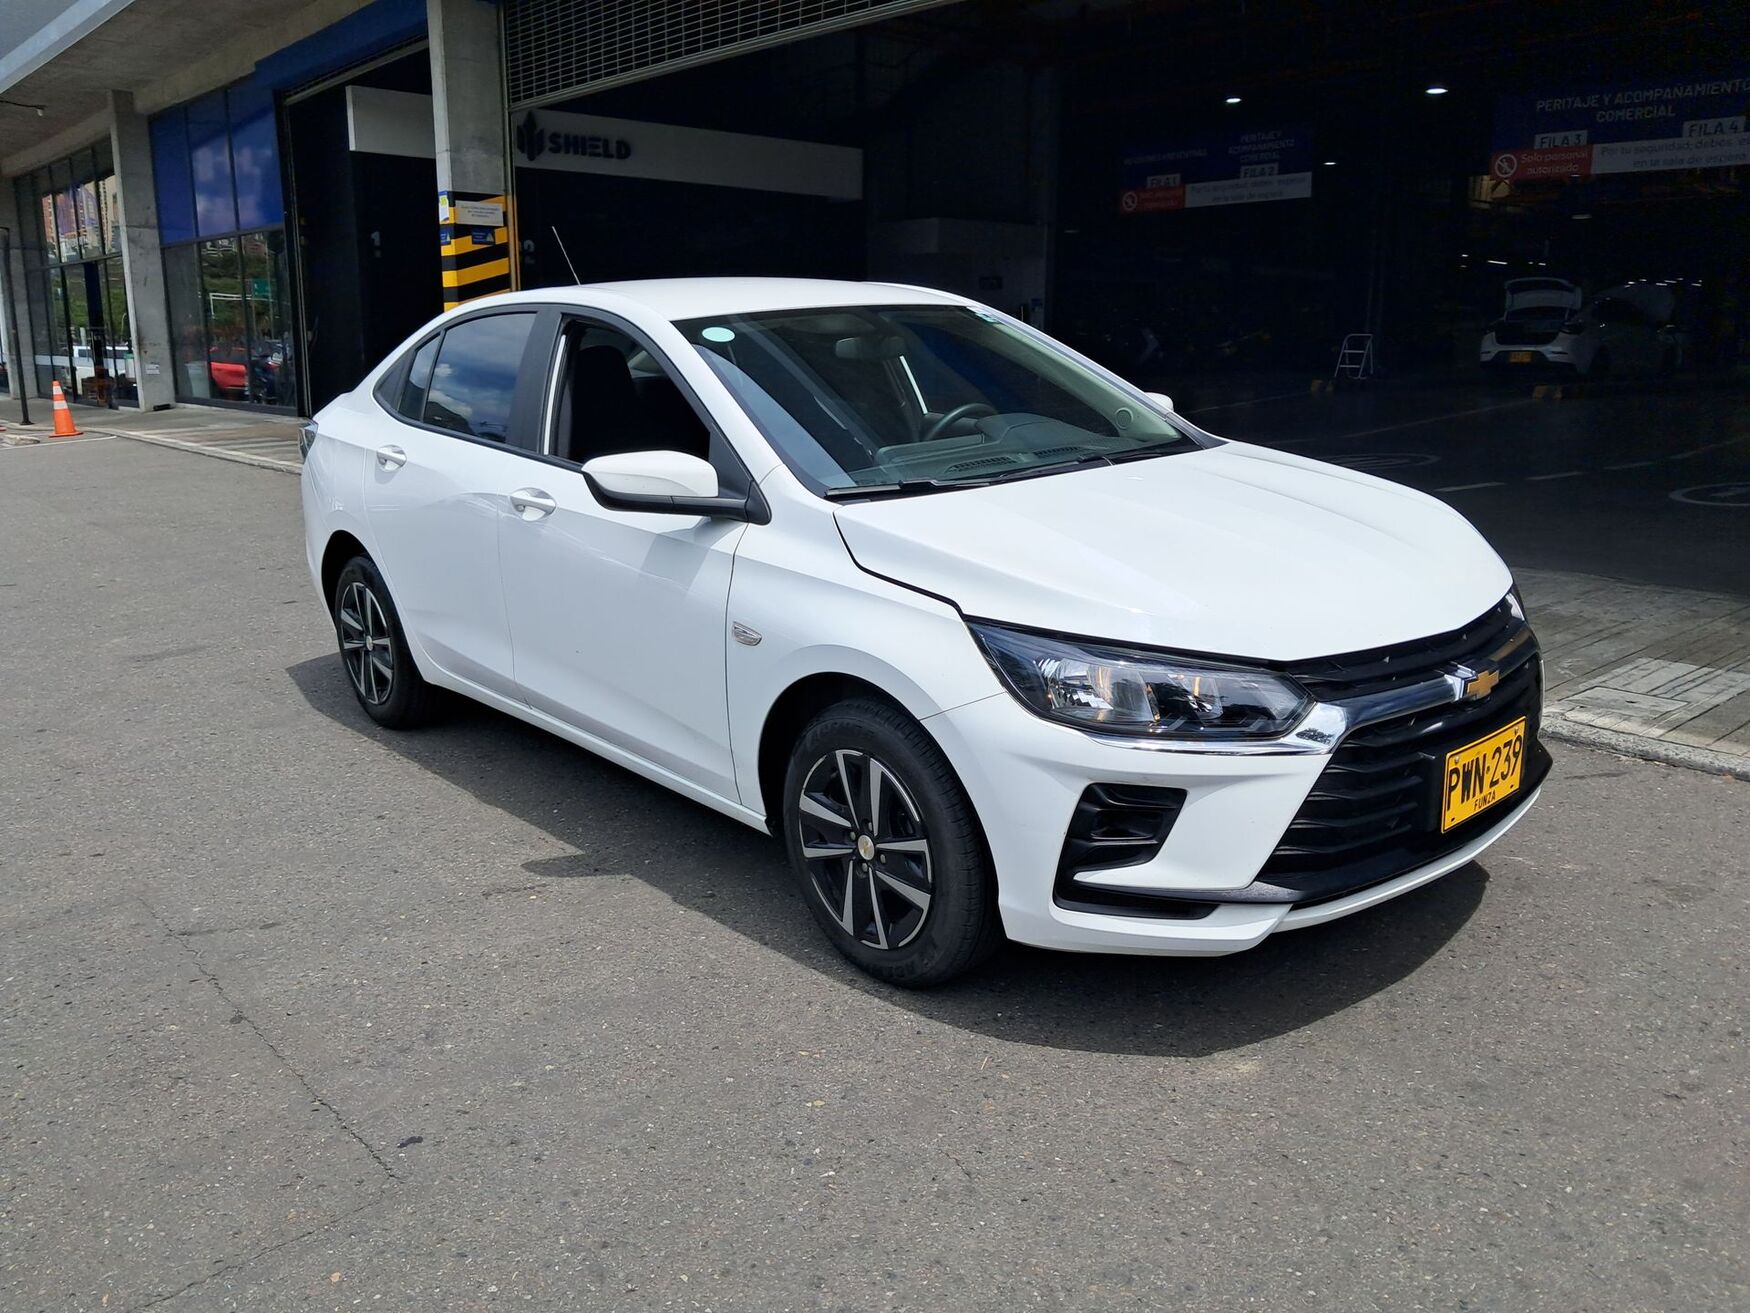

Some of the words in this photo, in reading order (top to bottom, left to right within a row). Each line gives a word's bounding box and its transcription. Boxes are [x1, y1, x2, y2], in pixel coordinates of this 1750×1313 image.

[1536, 95, 1600, 113] PERITAJE
[1603, 93, 1612, 106] Y
[1596, 105, 1676, 123] COMERCIAL
[1689, 122, 1725, 138] FILA
[1730, 119, 1739, 134] 4
[548, 132, 632, 160] SHIELD
[1539, 135, 1570, 148] FILA
[1574, 133, 1583, 145] 3
[1473, 789, 1496, 811] FUNZA
